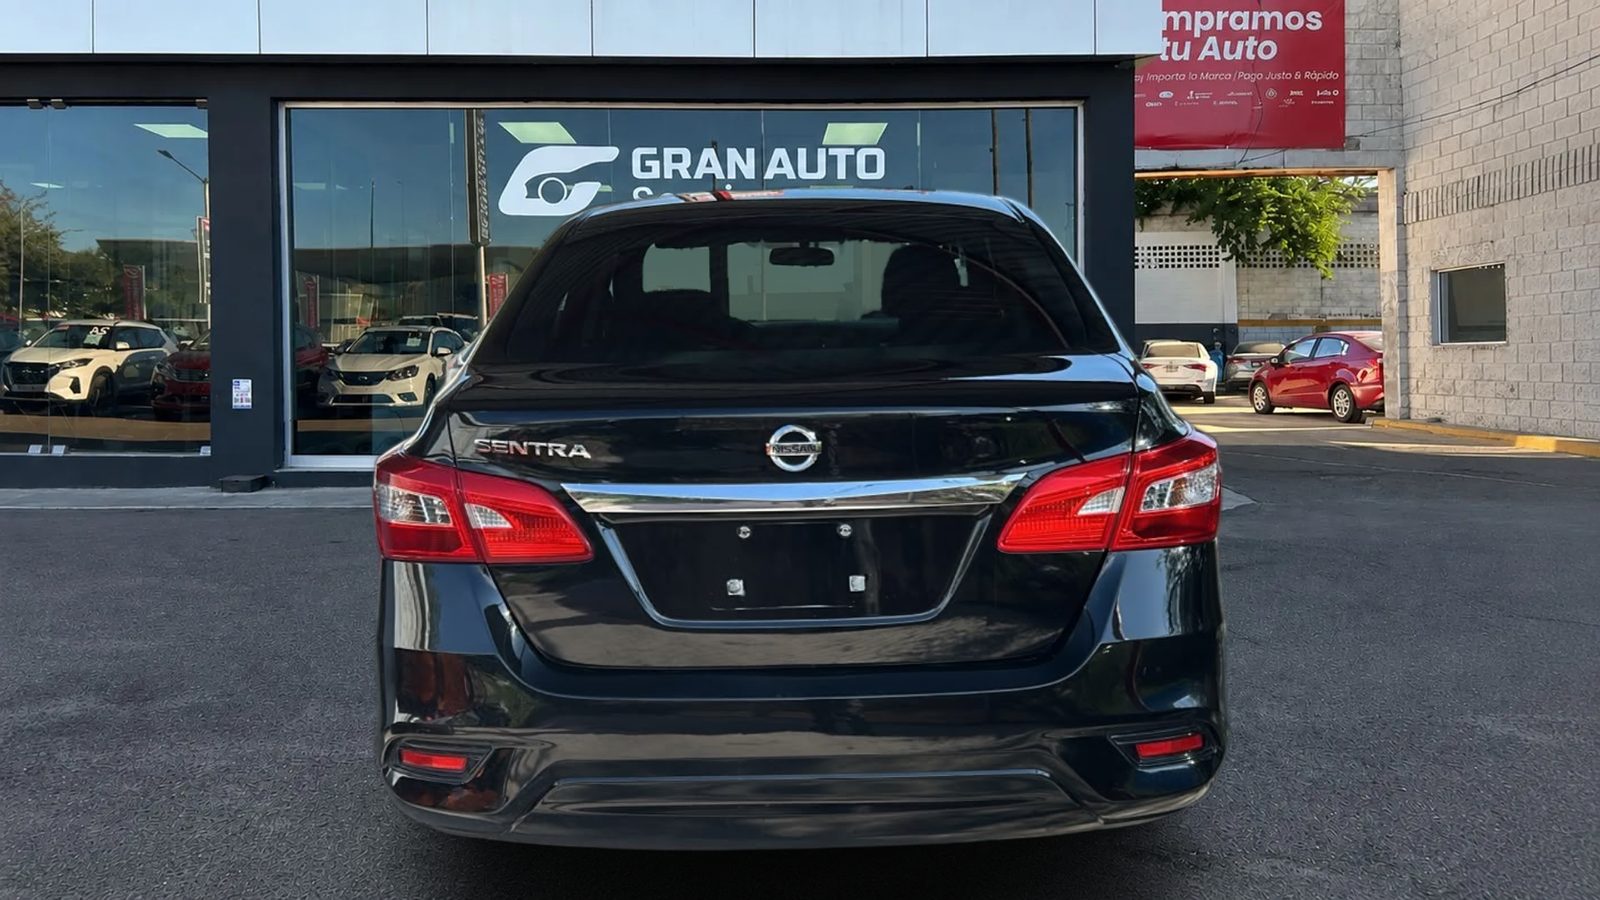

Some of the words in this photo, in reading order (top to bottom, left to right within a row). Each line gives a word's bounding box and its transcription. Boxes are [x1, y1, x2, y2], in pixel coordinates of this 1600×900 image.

[1160, 36, 1191, 61] tu
[1197, 35, 1278, 61] Auto
[1146, 72, 1186, 84] Importa
[1188, 71, 1198, 80] la
[1199, 71, 1232, 81] Marca
[1265, 71, 1293, 80] Justo
[1294, 70, 1301, 80] &
[631, 147, 755, 180] GRAN
[763, 147, 886, 180] AUTO
[474, 438, 592, 459] SENTRA
[772, 443, 817, 453] NISSAN
